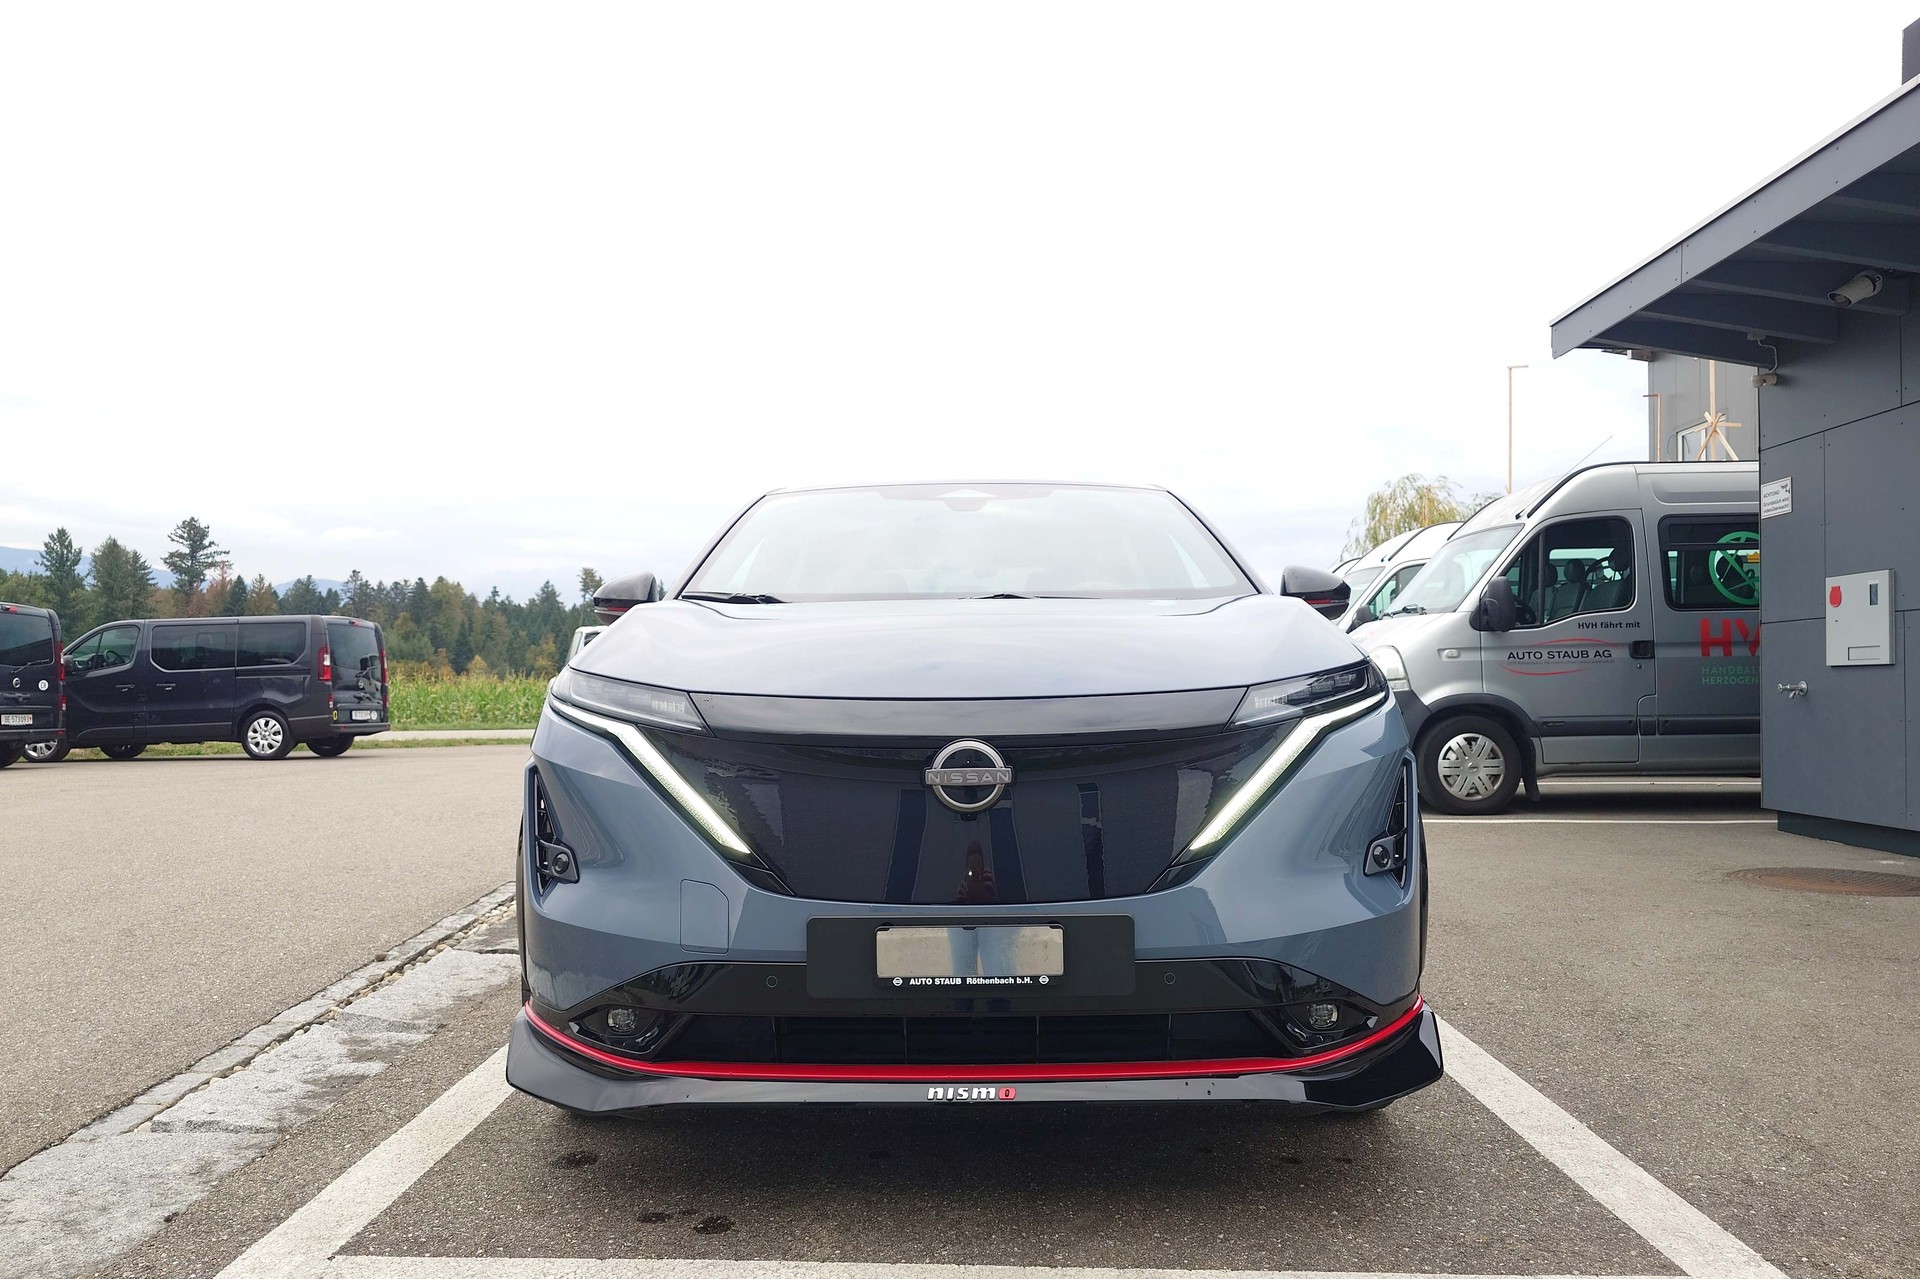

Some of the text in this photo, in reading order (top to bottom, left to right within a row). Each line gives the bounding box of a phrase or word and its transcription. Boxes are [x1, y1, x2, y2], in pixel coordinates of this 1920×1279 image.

[1600, 621, 1623, 629] fährt
[1625, 621, 1641, 629] mit
[1507, 649, 1612, 660] AUTO STAUB AG
[1702, 676, 1759, 685] HERZOGEN
[928, 772, 1009, 784] NISSAN
[934, 977, 962, 985] STAUB
[966, 976, 1015, 985] Röthenbach
[1016, 976, 1033, 984] b.H.
[927, 1087, 1017, 1100] nismo
